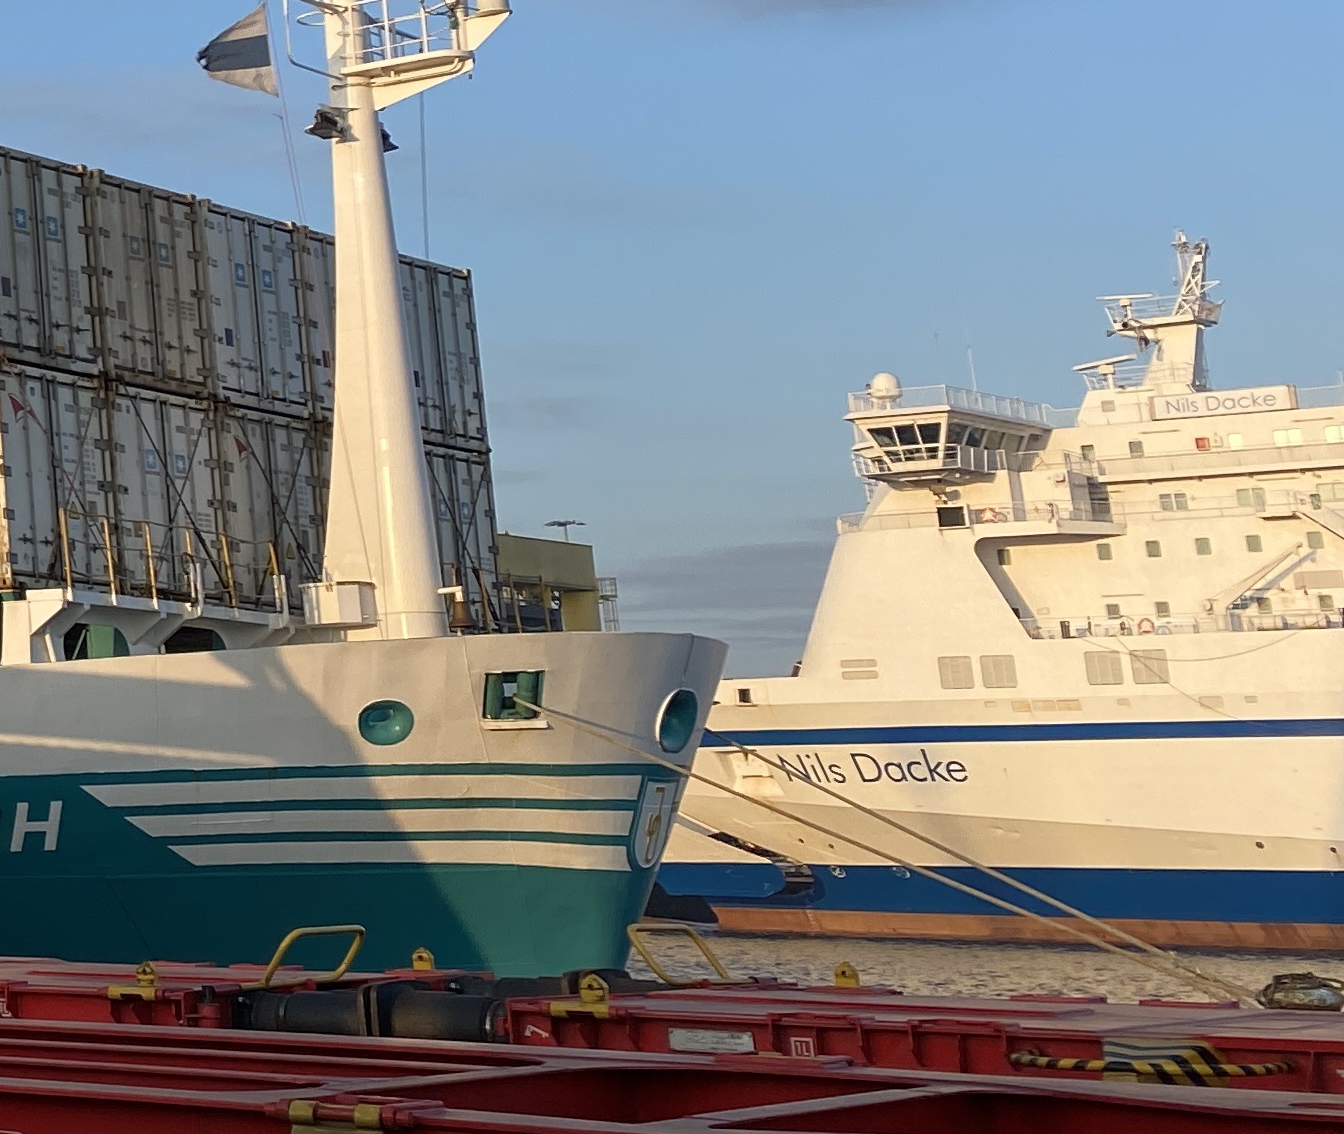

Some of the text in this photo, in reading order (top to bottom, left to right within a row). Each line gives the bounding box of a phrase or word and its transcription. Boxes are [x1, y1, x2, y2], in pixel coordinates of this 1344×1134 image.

[1165, 391, 1277, 415] Nils Dacke
[776, 748, 969, 784] Nils Dacke
